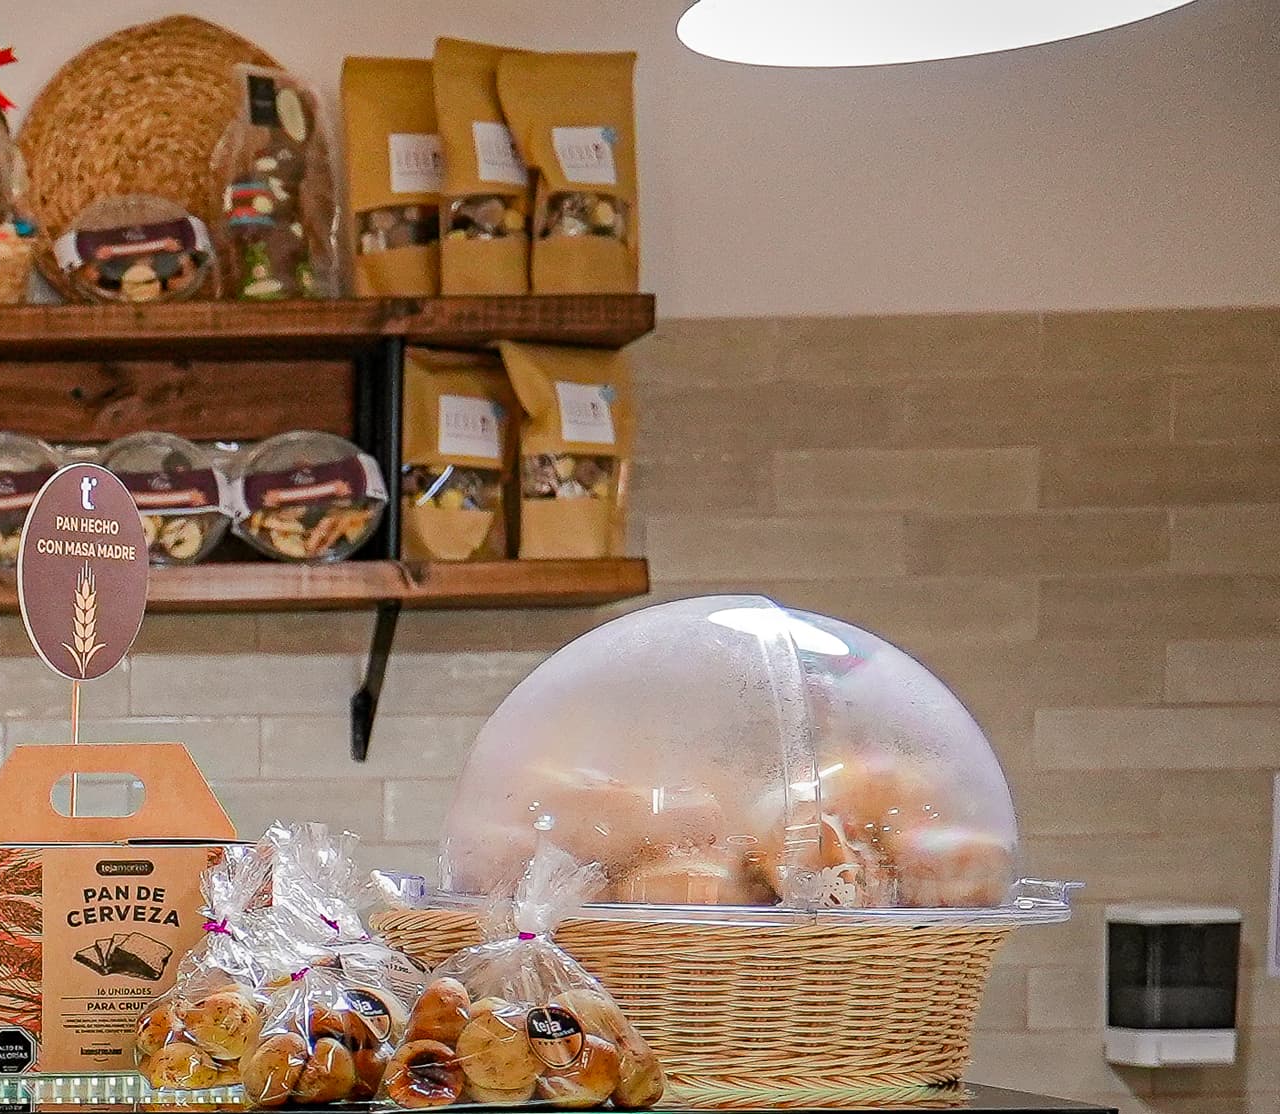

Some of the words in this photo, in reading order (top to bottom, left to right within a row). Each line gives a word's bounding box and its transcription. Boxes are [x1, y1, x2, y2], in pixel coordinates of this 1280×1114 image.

[55, 516, 79, 533] PAN
[80, 518, 120, 536] HECHO
[36, 539, 64, 555] CON
[64, 541, 96, 558] MASA
[97, 544, 137, 562] MADRE
[83, 885, 130, 903] PAN
[136, 886, 166, 903] DE
[66, 905, 180, 928] CERVEZA
[96, 988, 107, 996] 16
[108, 988, 152, 996] UNIDADES
[87, 1002, 116, 1011] PARA
[532, 1018, 562, 1036] teja
